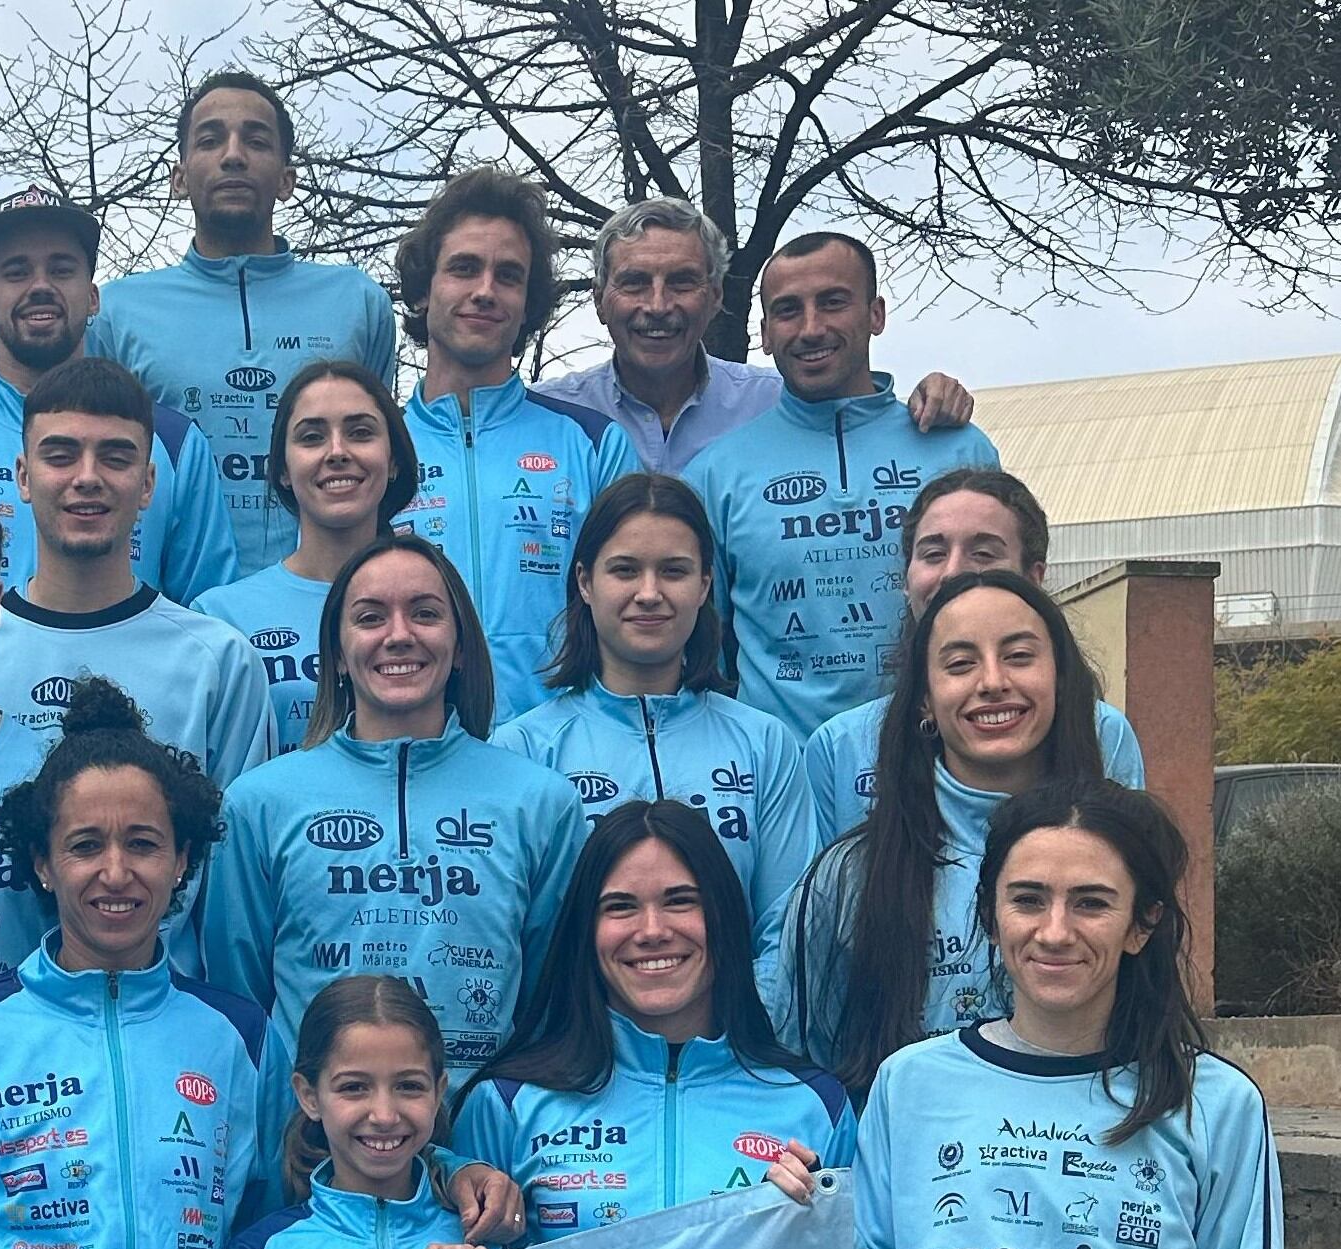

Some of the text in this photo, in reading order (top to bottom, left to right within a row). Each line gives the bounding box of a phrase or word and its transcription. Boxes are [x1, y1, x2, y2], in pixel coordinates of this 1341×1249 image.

[228, 369, 274, 387] TROPS
[873, 459, 922, 490] als
[766, 478, 826, 502] TROPS
[780, 499, 909, 542] nerja
[802, 542, 900, 565] ATLETISMO
[815, 575, 854, 586] metro
[251, 632, 298, 647] TROPS
[826, 651, 866, 666] activa
[28, 710, 63, 724] activa
[578, 777, 616, 799] OPS
[309, 818, 382, 844] TROPS
[435, 808, 495, 848] als
[327, 854, 481, 907] nerja
[350, 908, 459, 927] ATLETISMO
[362, 941, 408, 953] metro
[450, 945, 495, 961] CUEVA
[362, 953, 408, 968] Málaga
[177, 1078, 215, 1103] TROPS
[0, 1105, 72, 1132] ATLETISMO
[530, 1118, 628, 1156] nerja
[997, 1117, 1095, 1146] Andalucía
[736, 1139, 787, 1159] TROPS
[1000, 1145, 1048, 1162] activa
[540, 1153, 613, 1169] ATLETISMO
[29, 1197, 90, 1221] activa
[1121, 1200, 1154, 1217] nerja
[1119, 1212, 1162, 1229] Centro
[1118, 1224, 1159, 1245] aen
